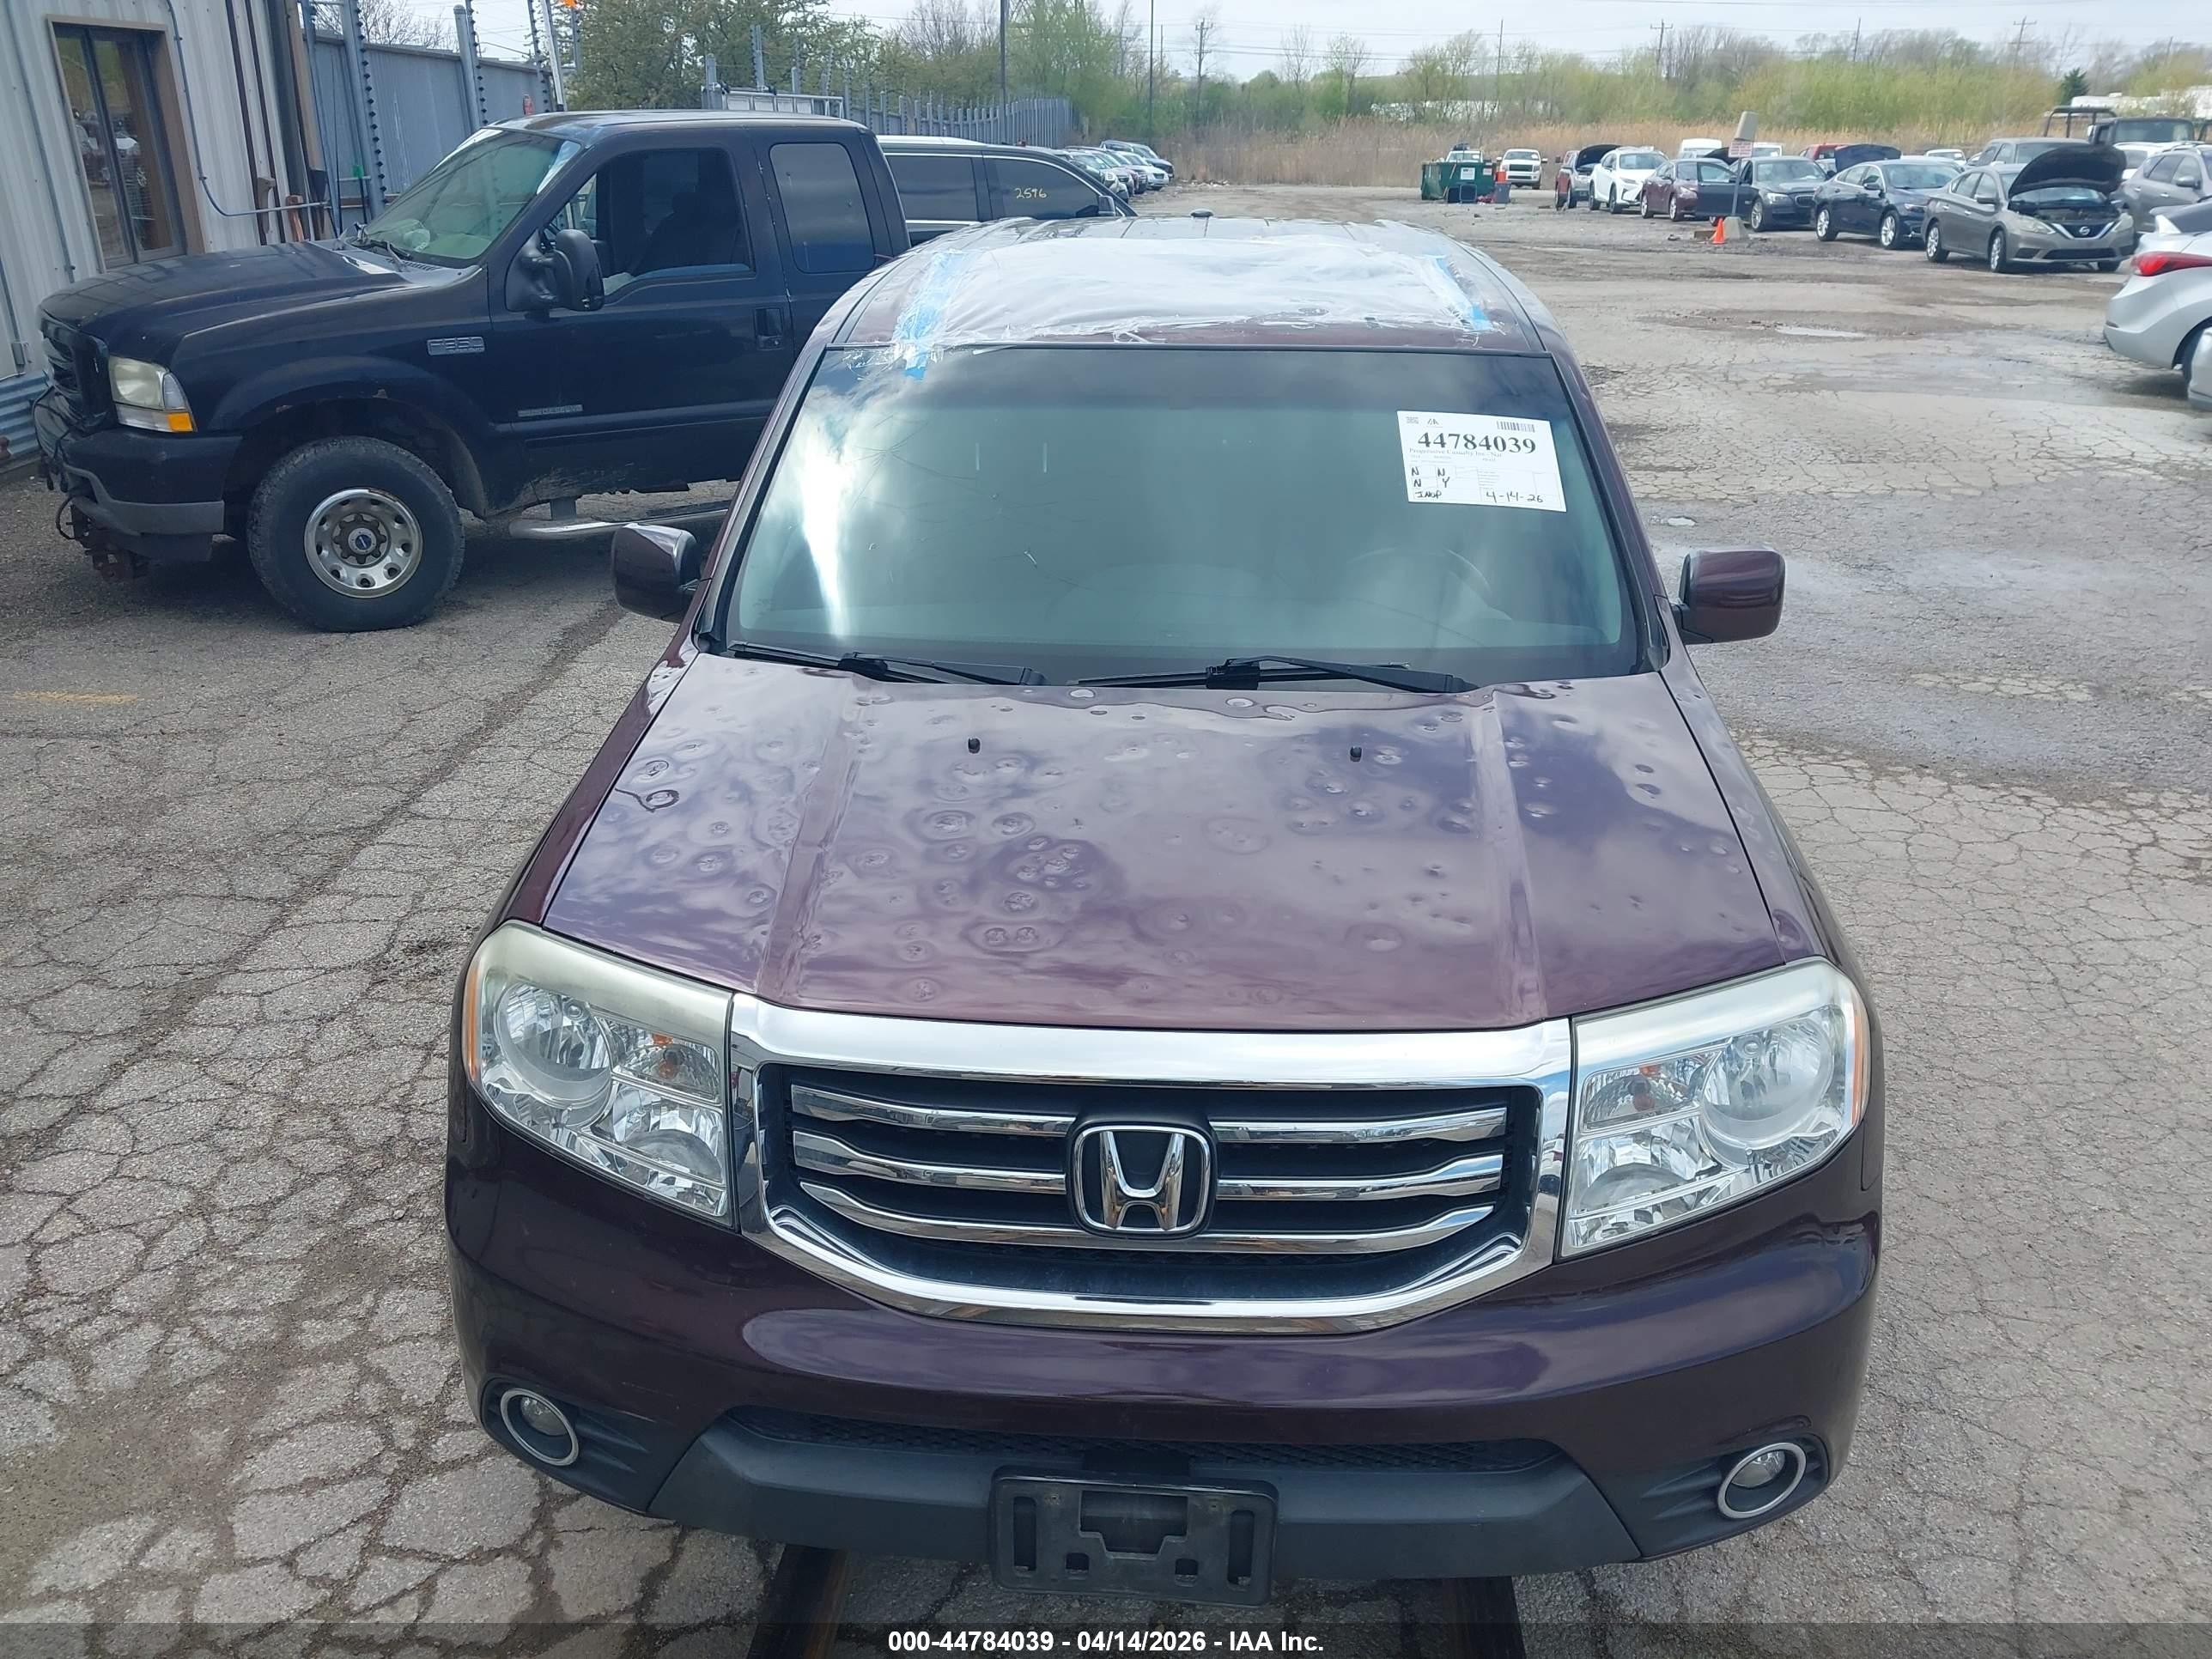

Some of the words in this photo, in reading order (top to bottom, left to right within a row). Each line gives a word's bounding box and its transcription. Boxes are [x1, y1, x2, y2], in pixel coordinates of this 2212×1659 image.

[1417, 432, 1536, 454] 44784039
[1411, 466, 1419, 477] N
[1437, 467, 1445, 477] N
[1413, 478, 1421, 487] N
[1442, 477, 1449, 488] Y
[1486, 490, 1543, 503] 4-14-26
